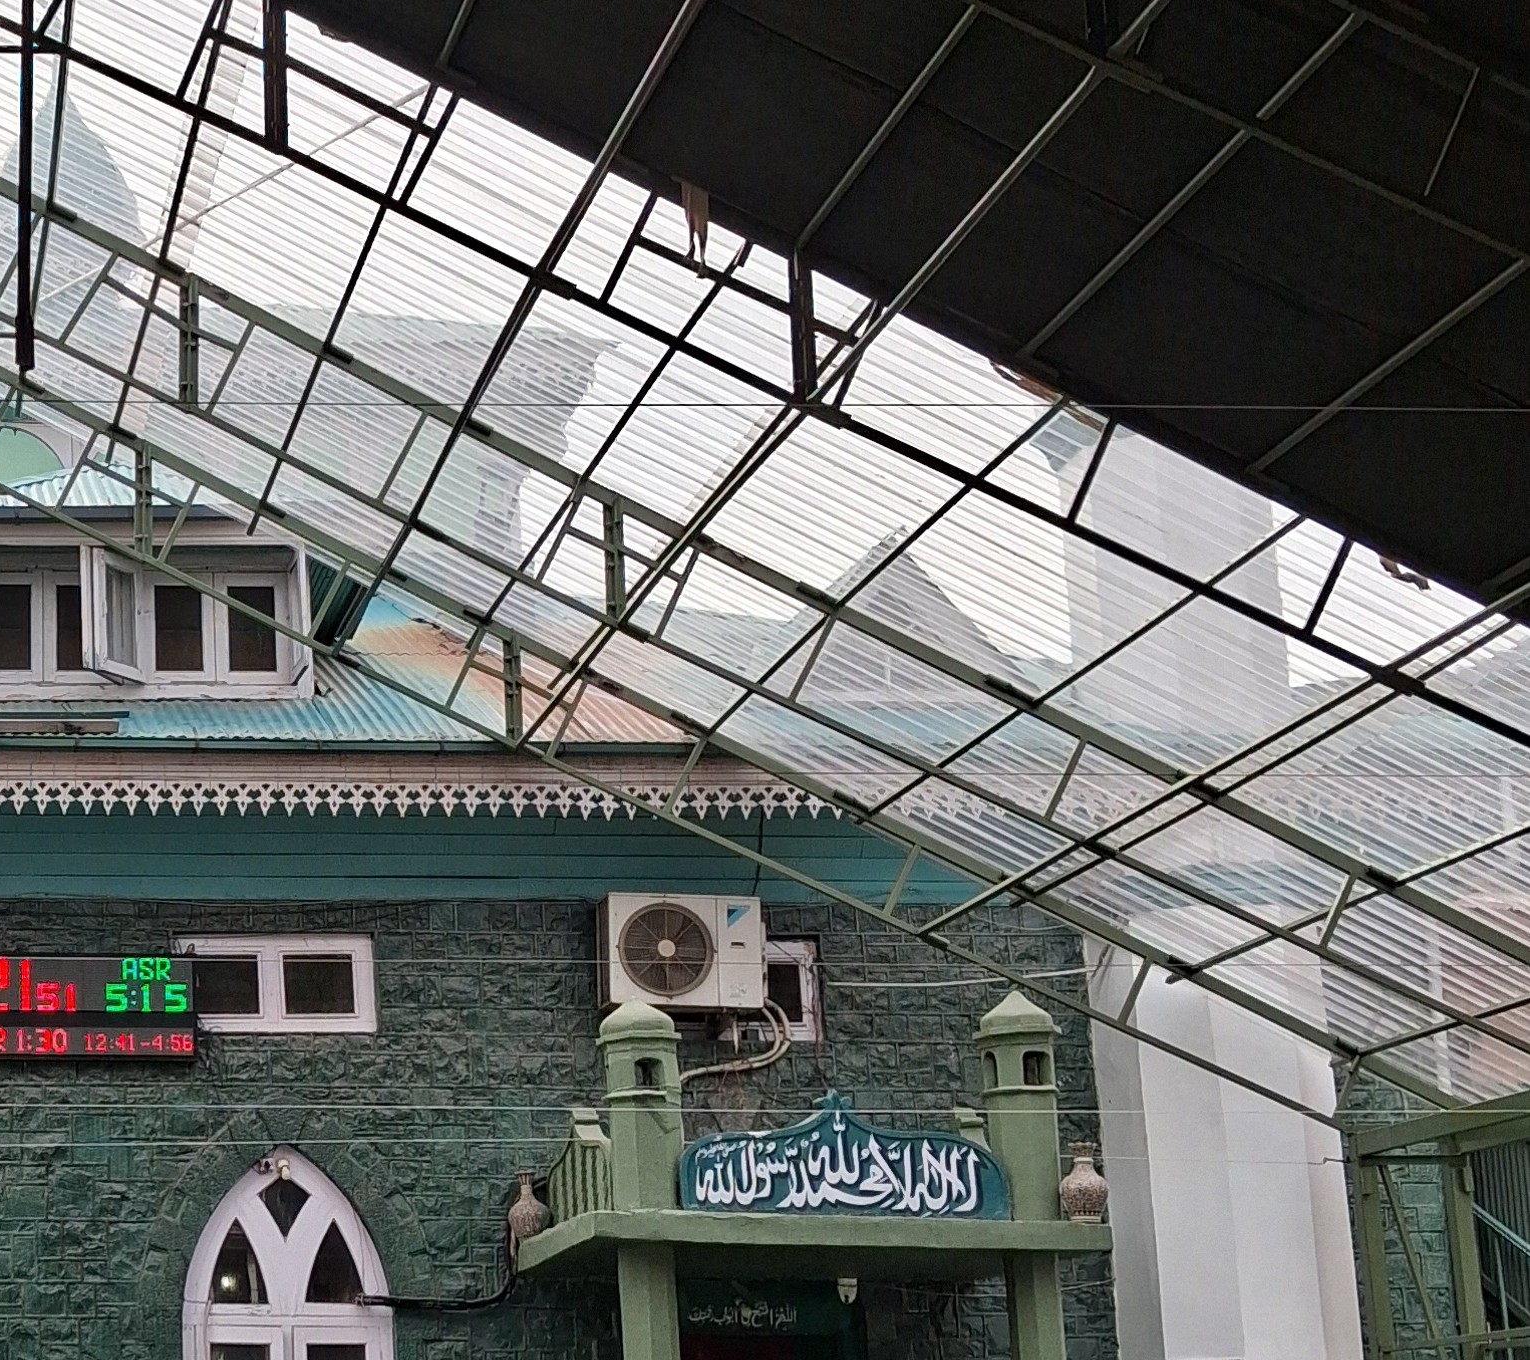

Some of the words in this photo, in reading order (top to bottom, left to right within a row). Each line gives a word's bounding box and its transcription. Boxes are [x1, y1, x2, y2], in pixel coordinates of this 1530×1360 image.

[122, 957, 171, 981] ASR
[105, 983, 188, 1013] 5:15
[16, 1027, 69, 1054] 1:30
